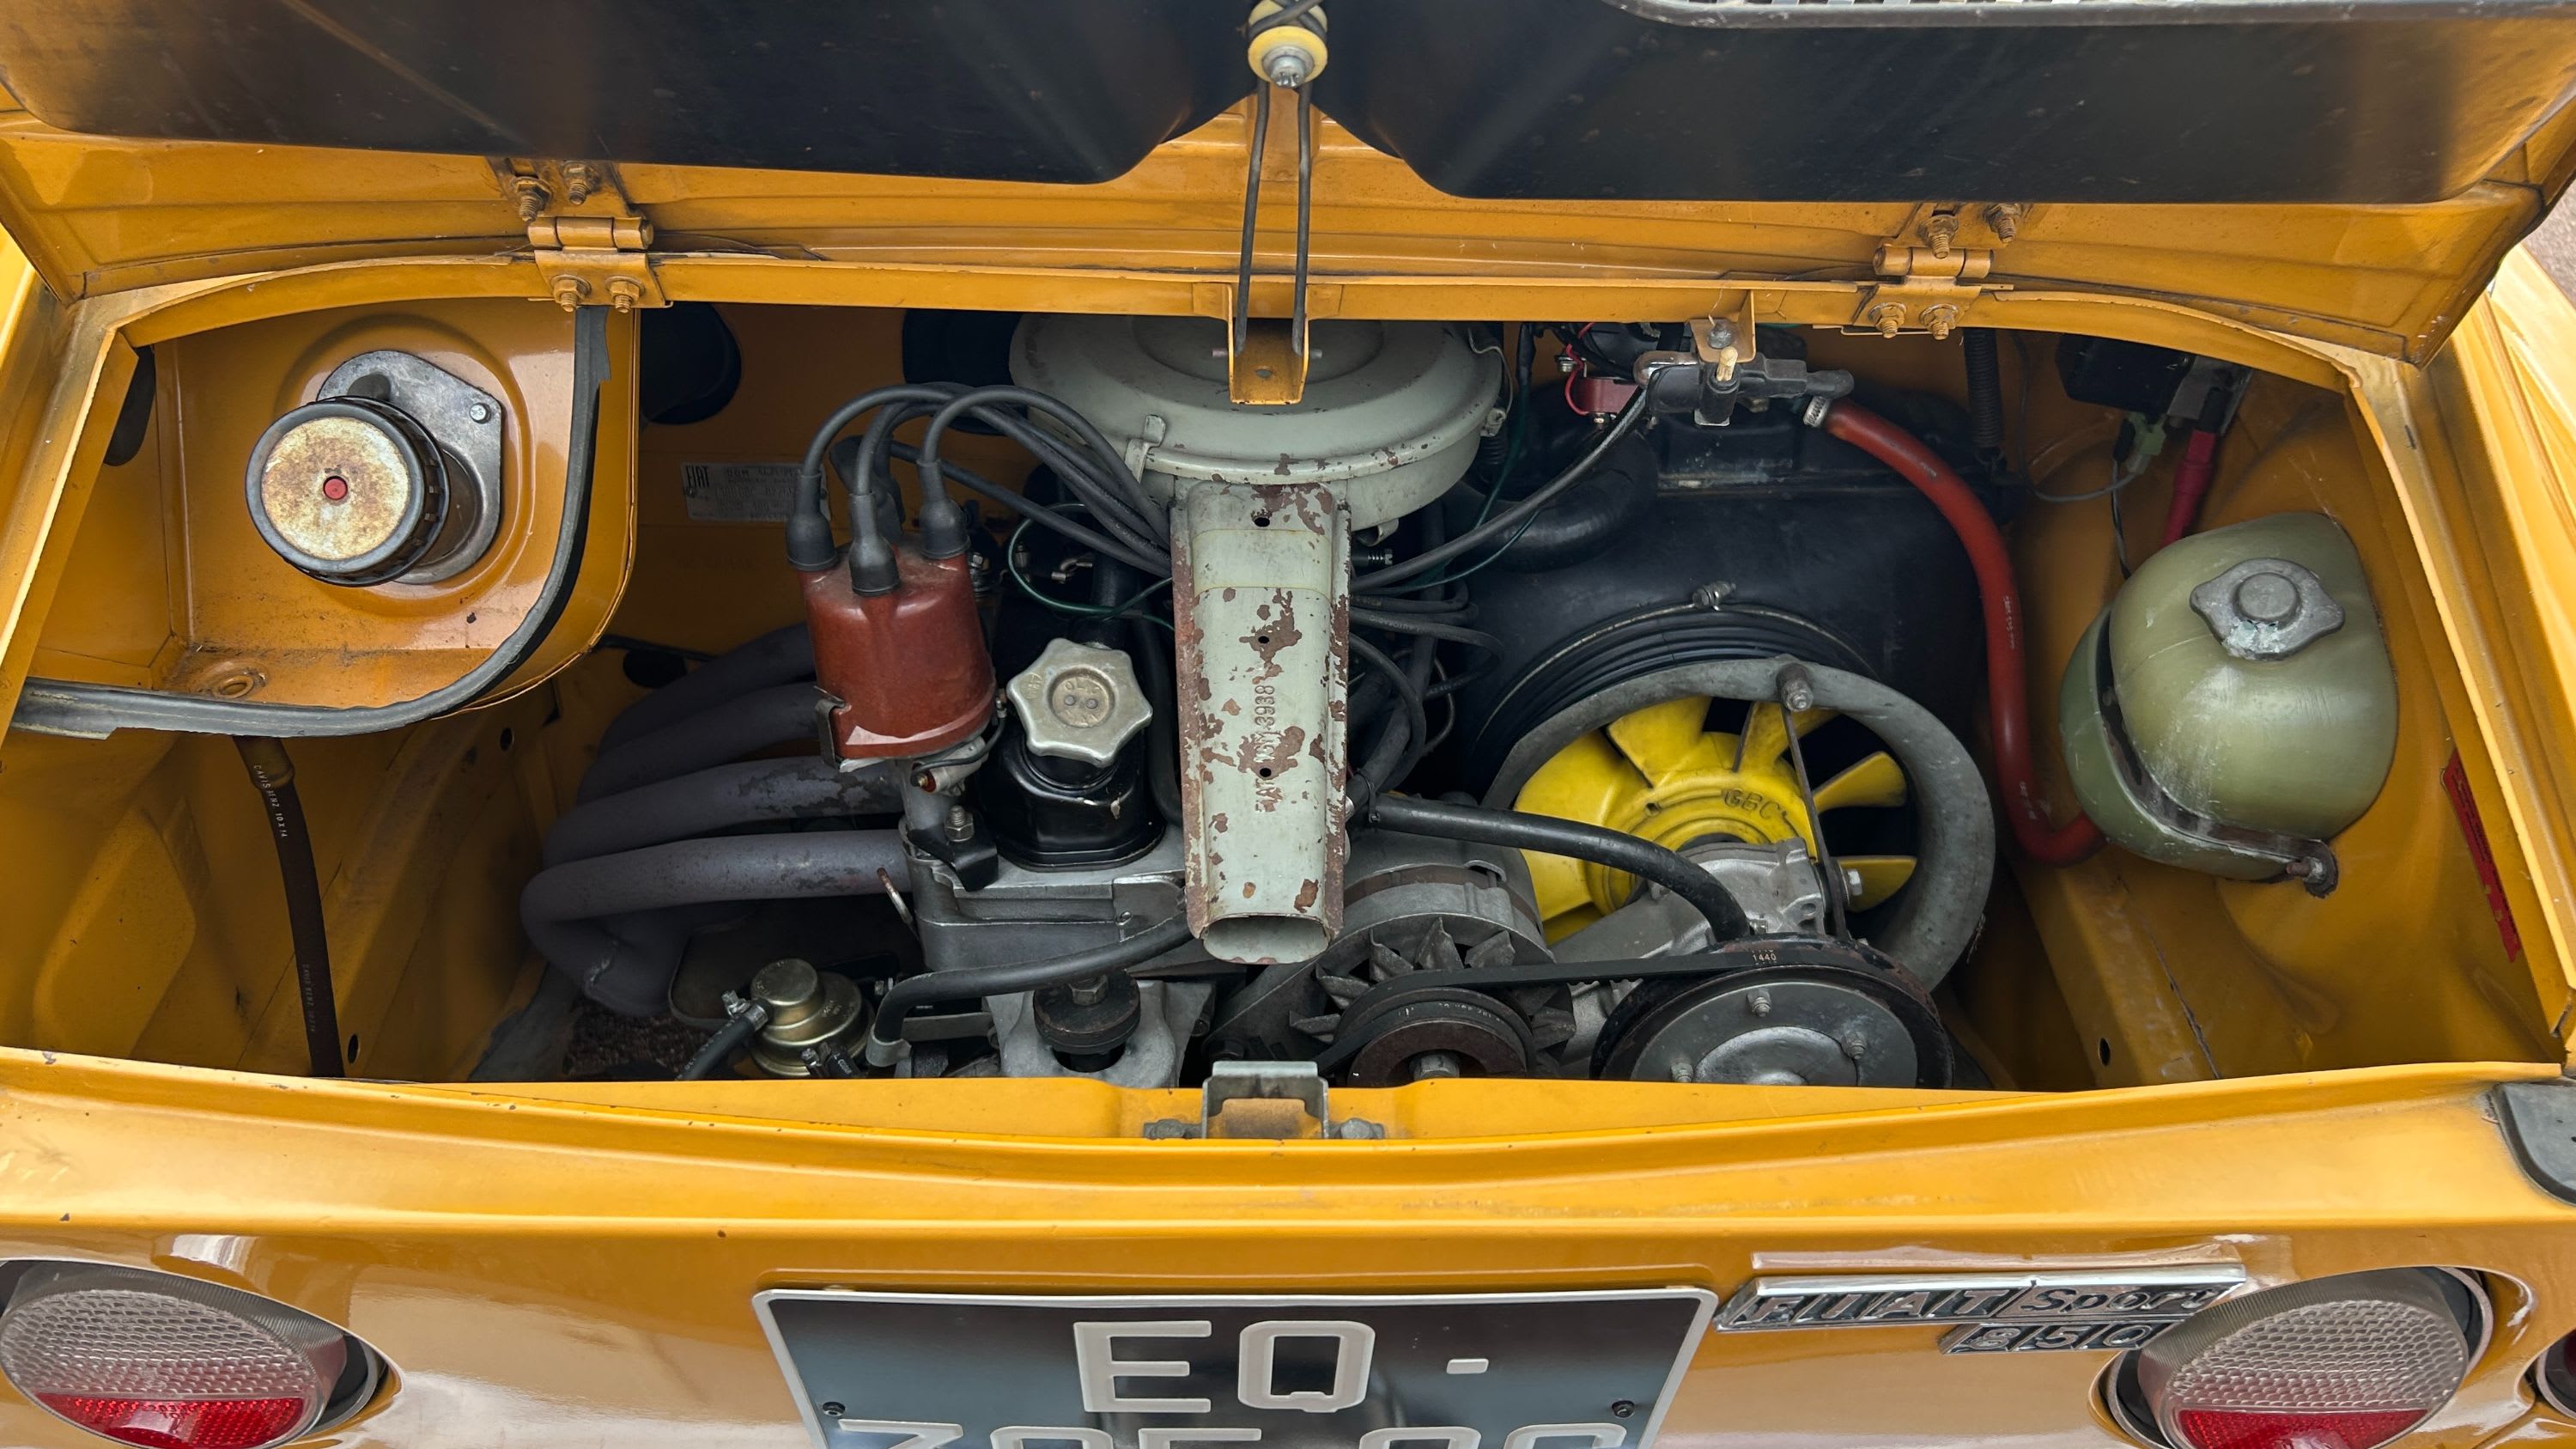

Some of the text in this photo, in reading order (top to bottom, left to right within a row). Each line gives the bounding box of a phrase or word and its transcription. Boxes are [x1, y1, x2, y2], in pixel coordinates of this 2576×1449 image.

[684, 465, 710, 488] FIAT
[1752, 952, 1777, 962] 1440
[1748, 1287, 2221, 1323] FIAT Sport
[1968, 1323, 2154, 1352] 850
[1073, 1320, 1376, 1413] EQ
